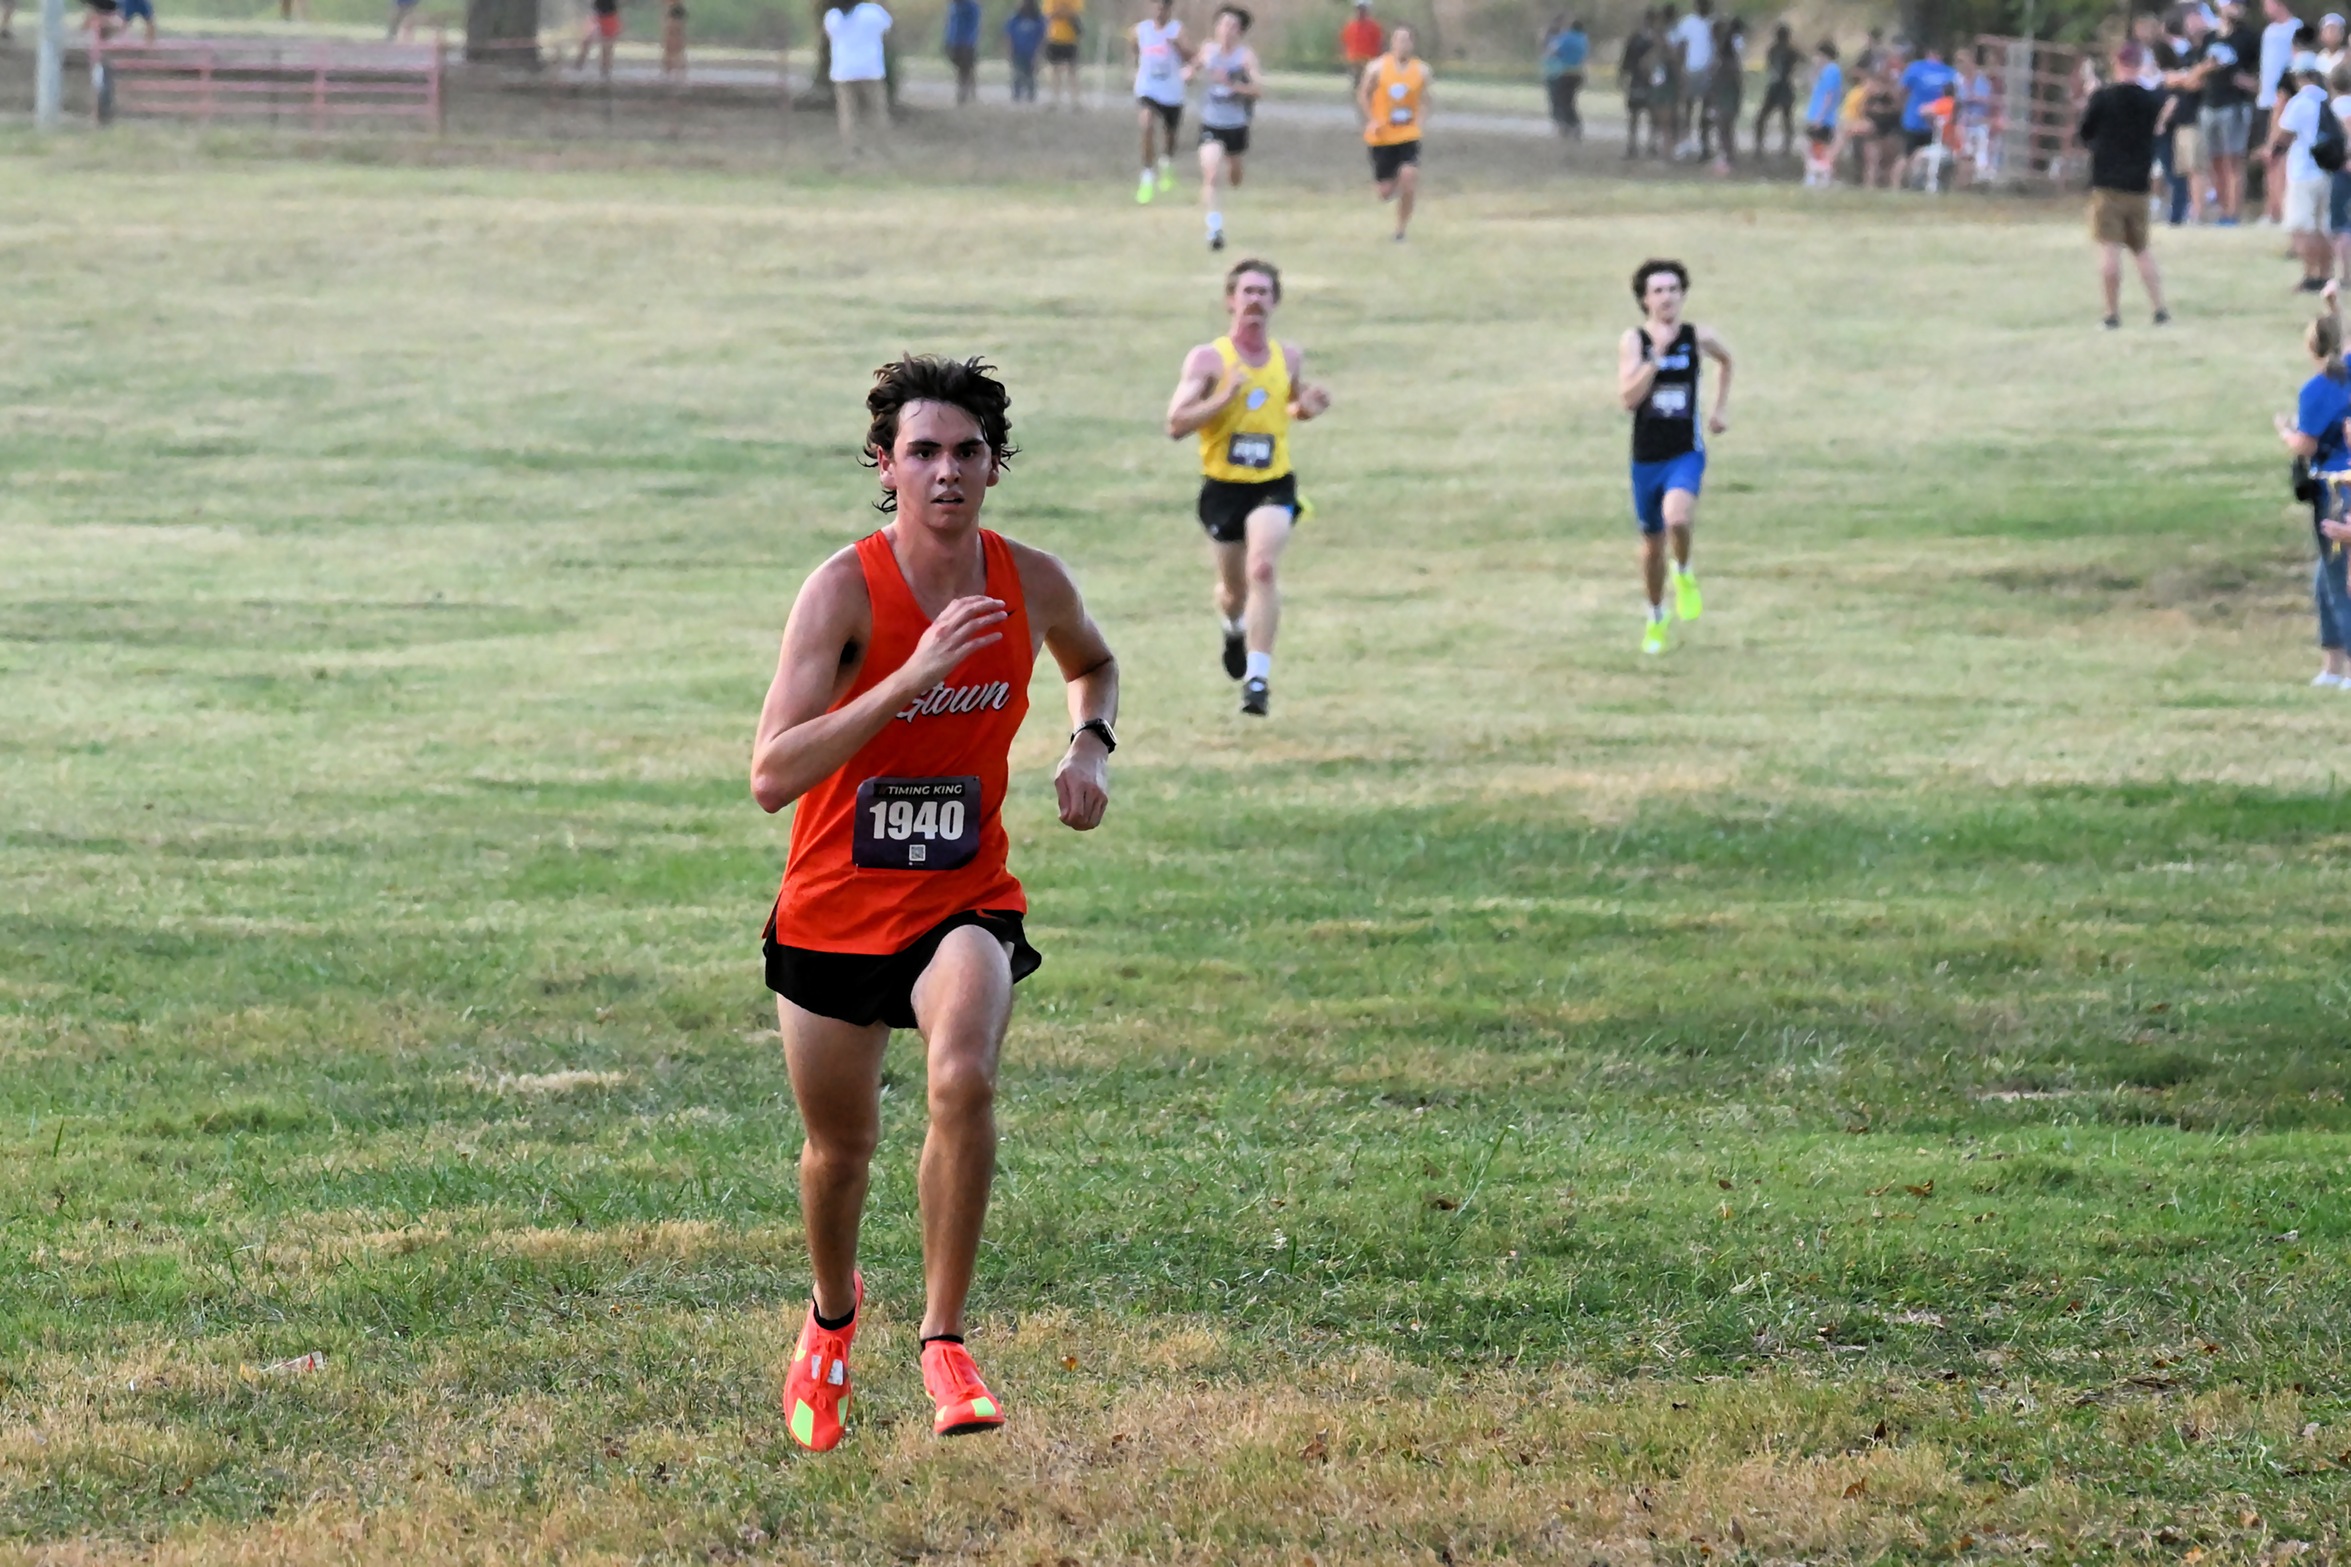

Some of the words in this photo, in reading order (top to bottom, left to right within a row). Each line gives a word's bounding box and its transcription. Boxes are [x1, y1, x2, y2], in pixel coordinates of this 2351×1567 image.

[888, 785, 930, 795] TIMING
[933, 784, 963, 795] KING
[869, 800, 965, 841] 1940
